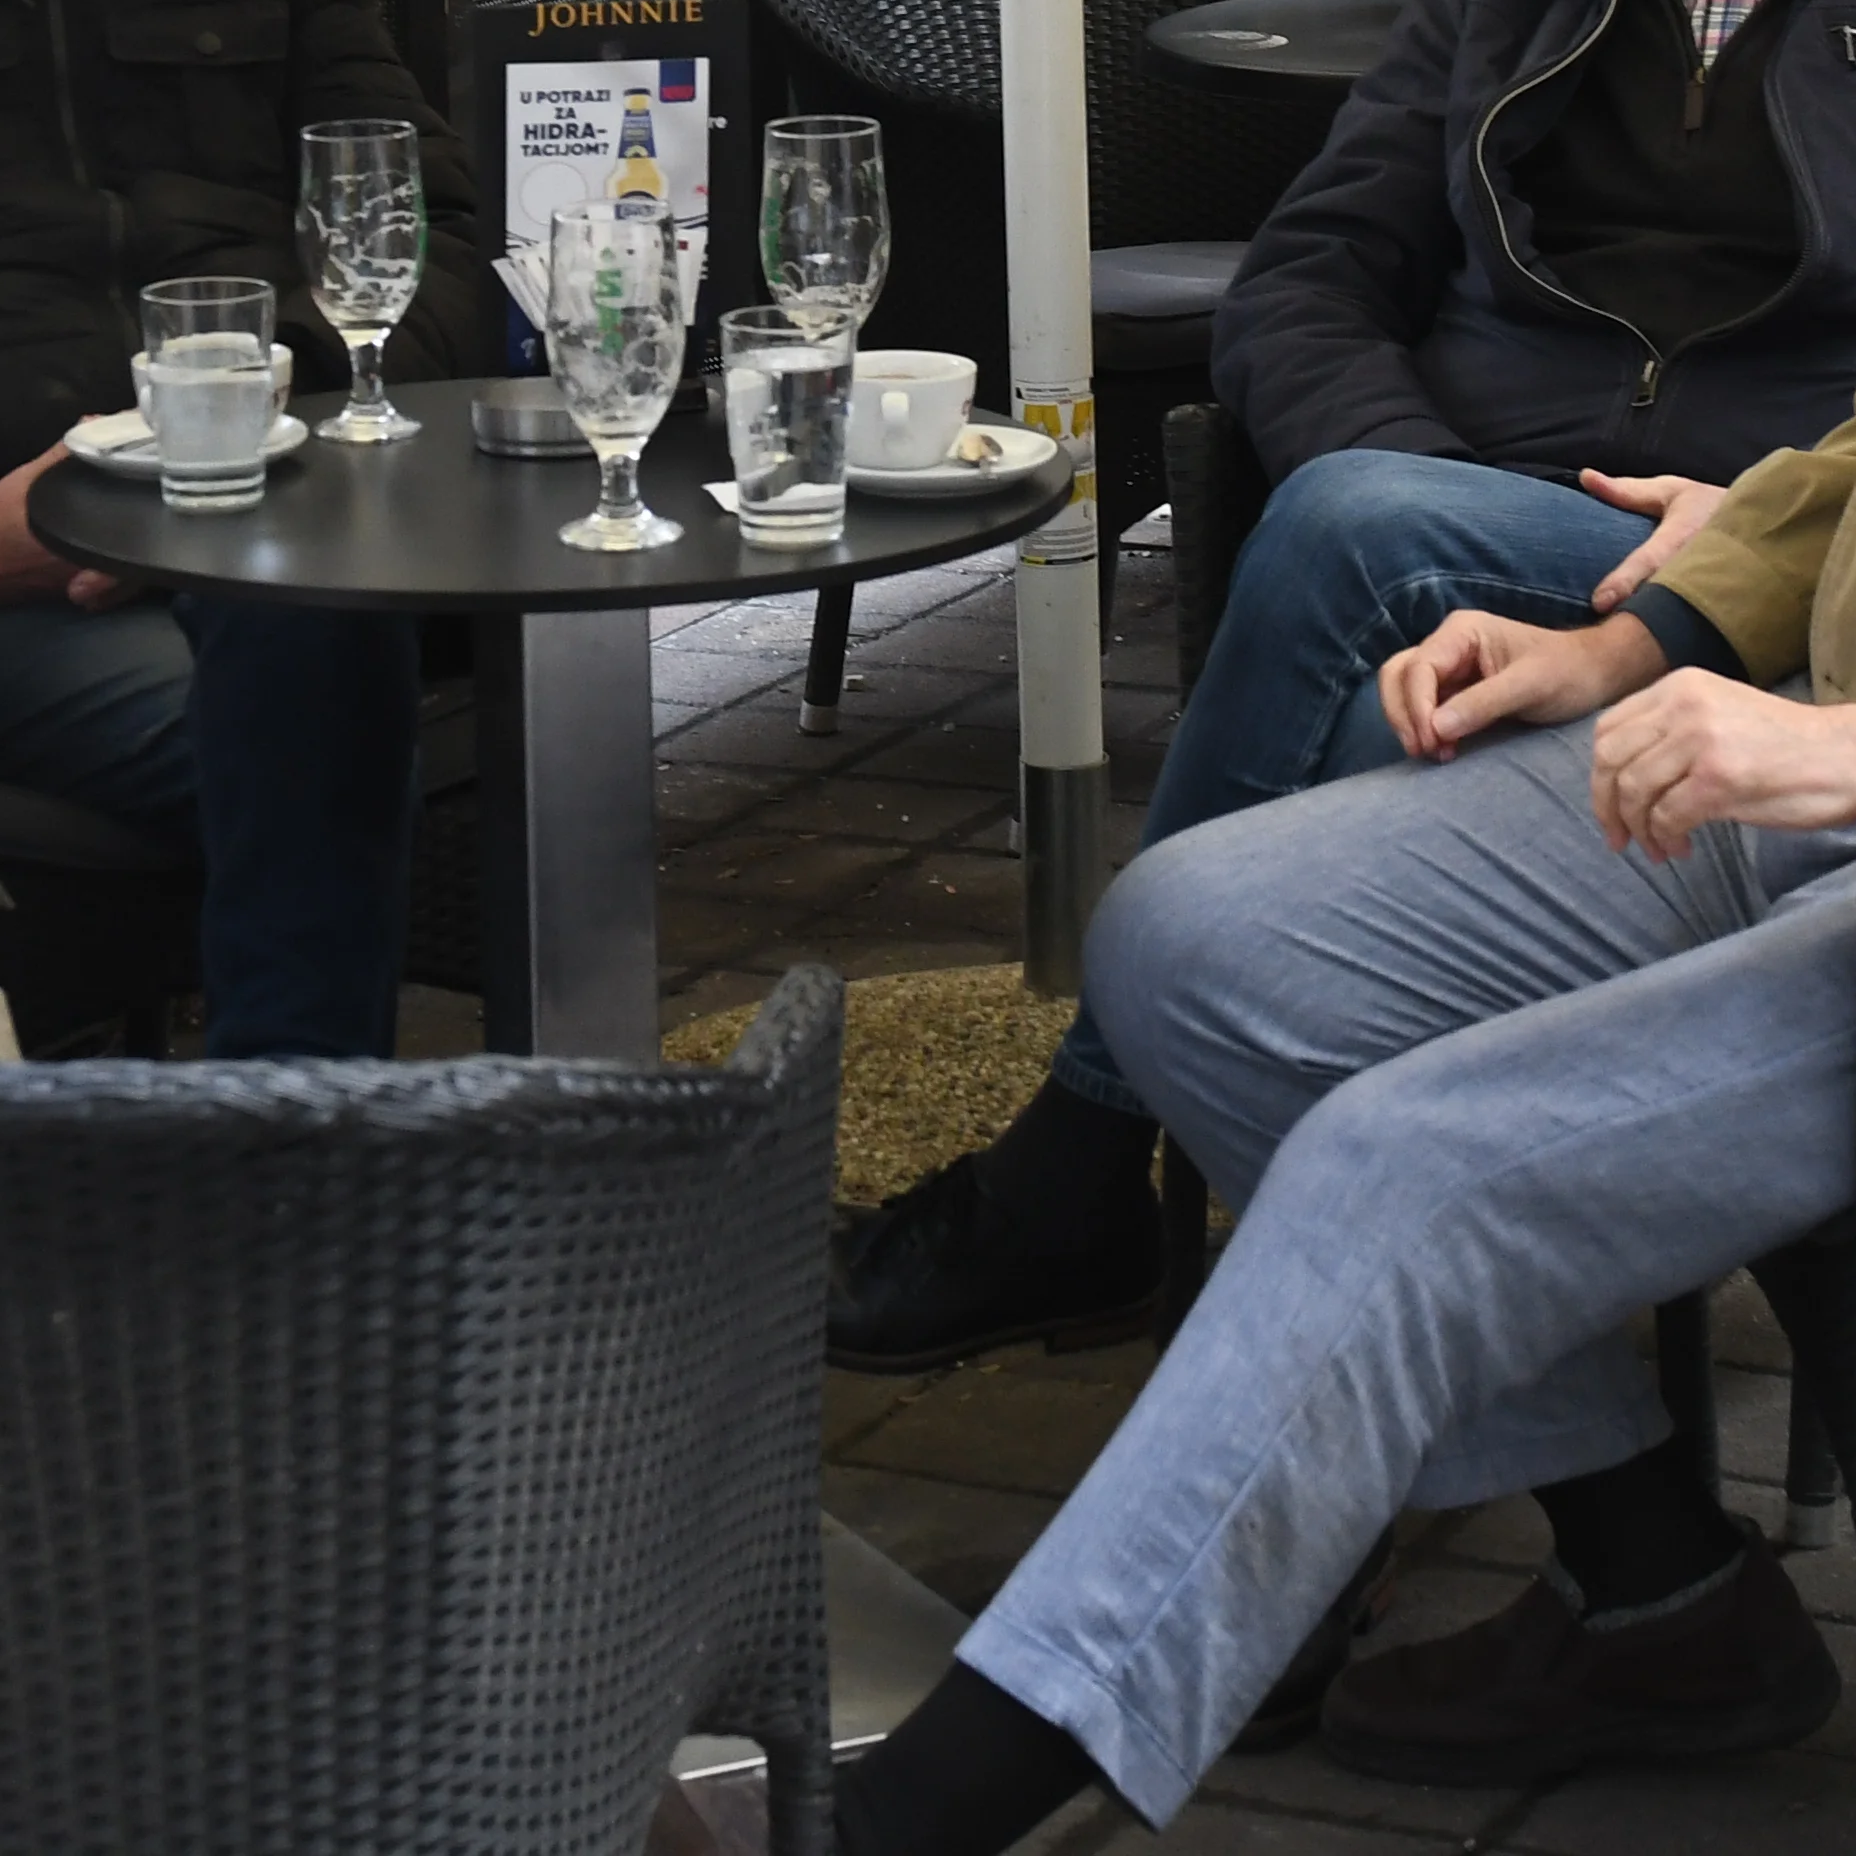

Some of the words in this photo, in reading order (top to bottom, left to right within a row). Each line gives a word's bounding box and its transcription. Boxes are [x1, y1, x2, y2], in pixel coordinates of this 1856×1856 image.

[520, 91, 532, 104] U
[536, 89, 611, 104] POTRAZI
[554, 107, 577, 120] ZA
[523, 122, 608, 141] HIDRA-
[520, 143, 610, 158] TACIJOM?
